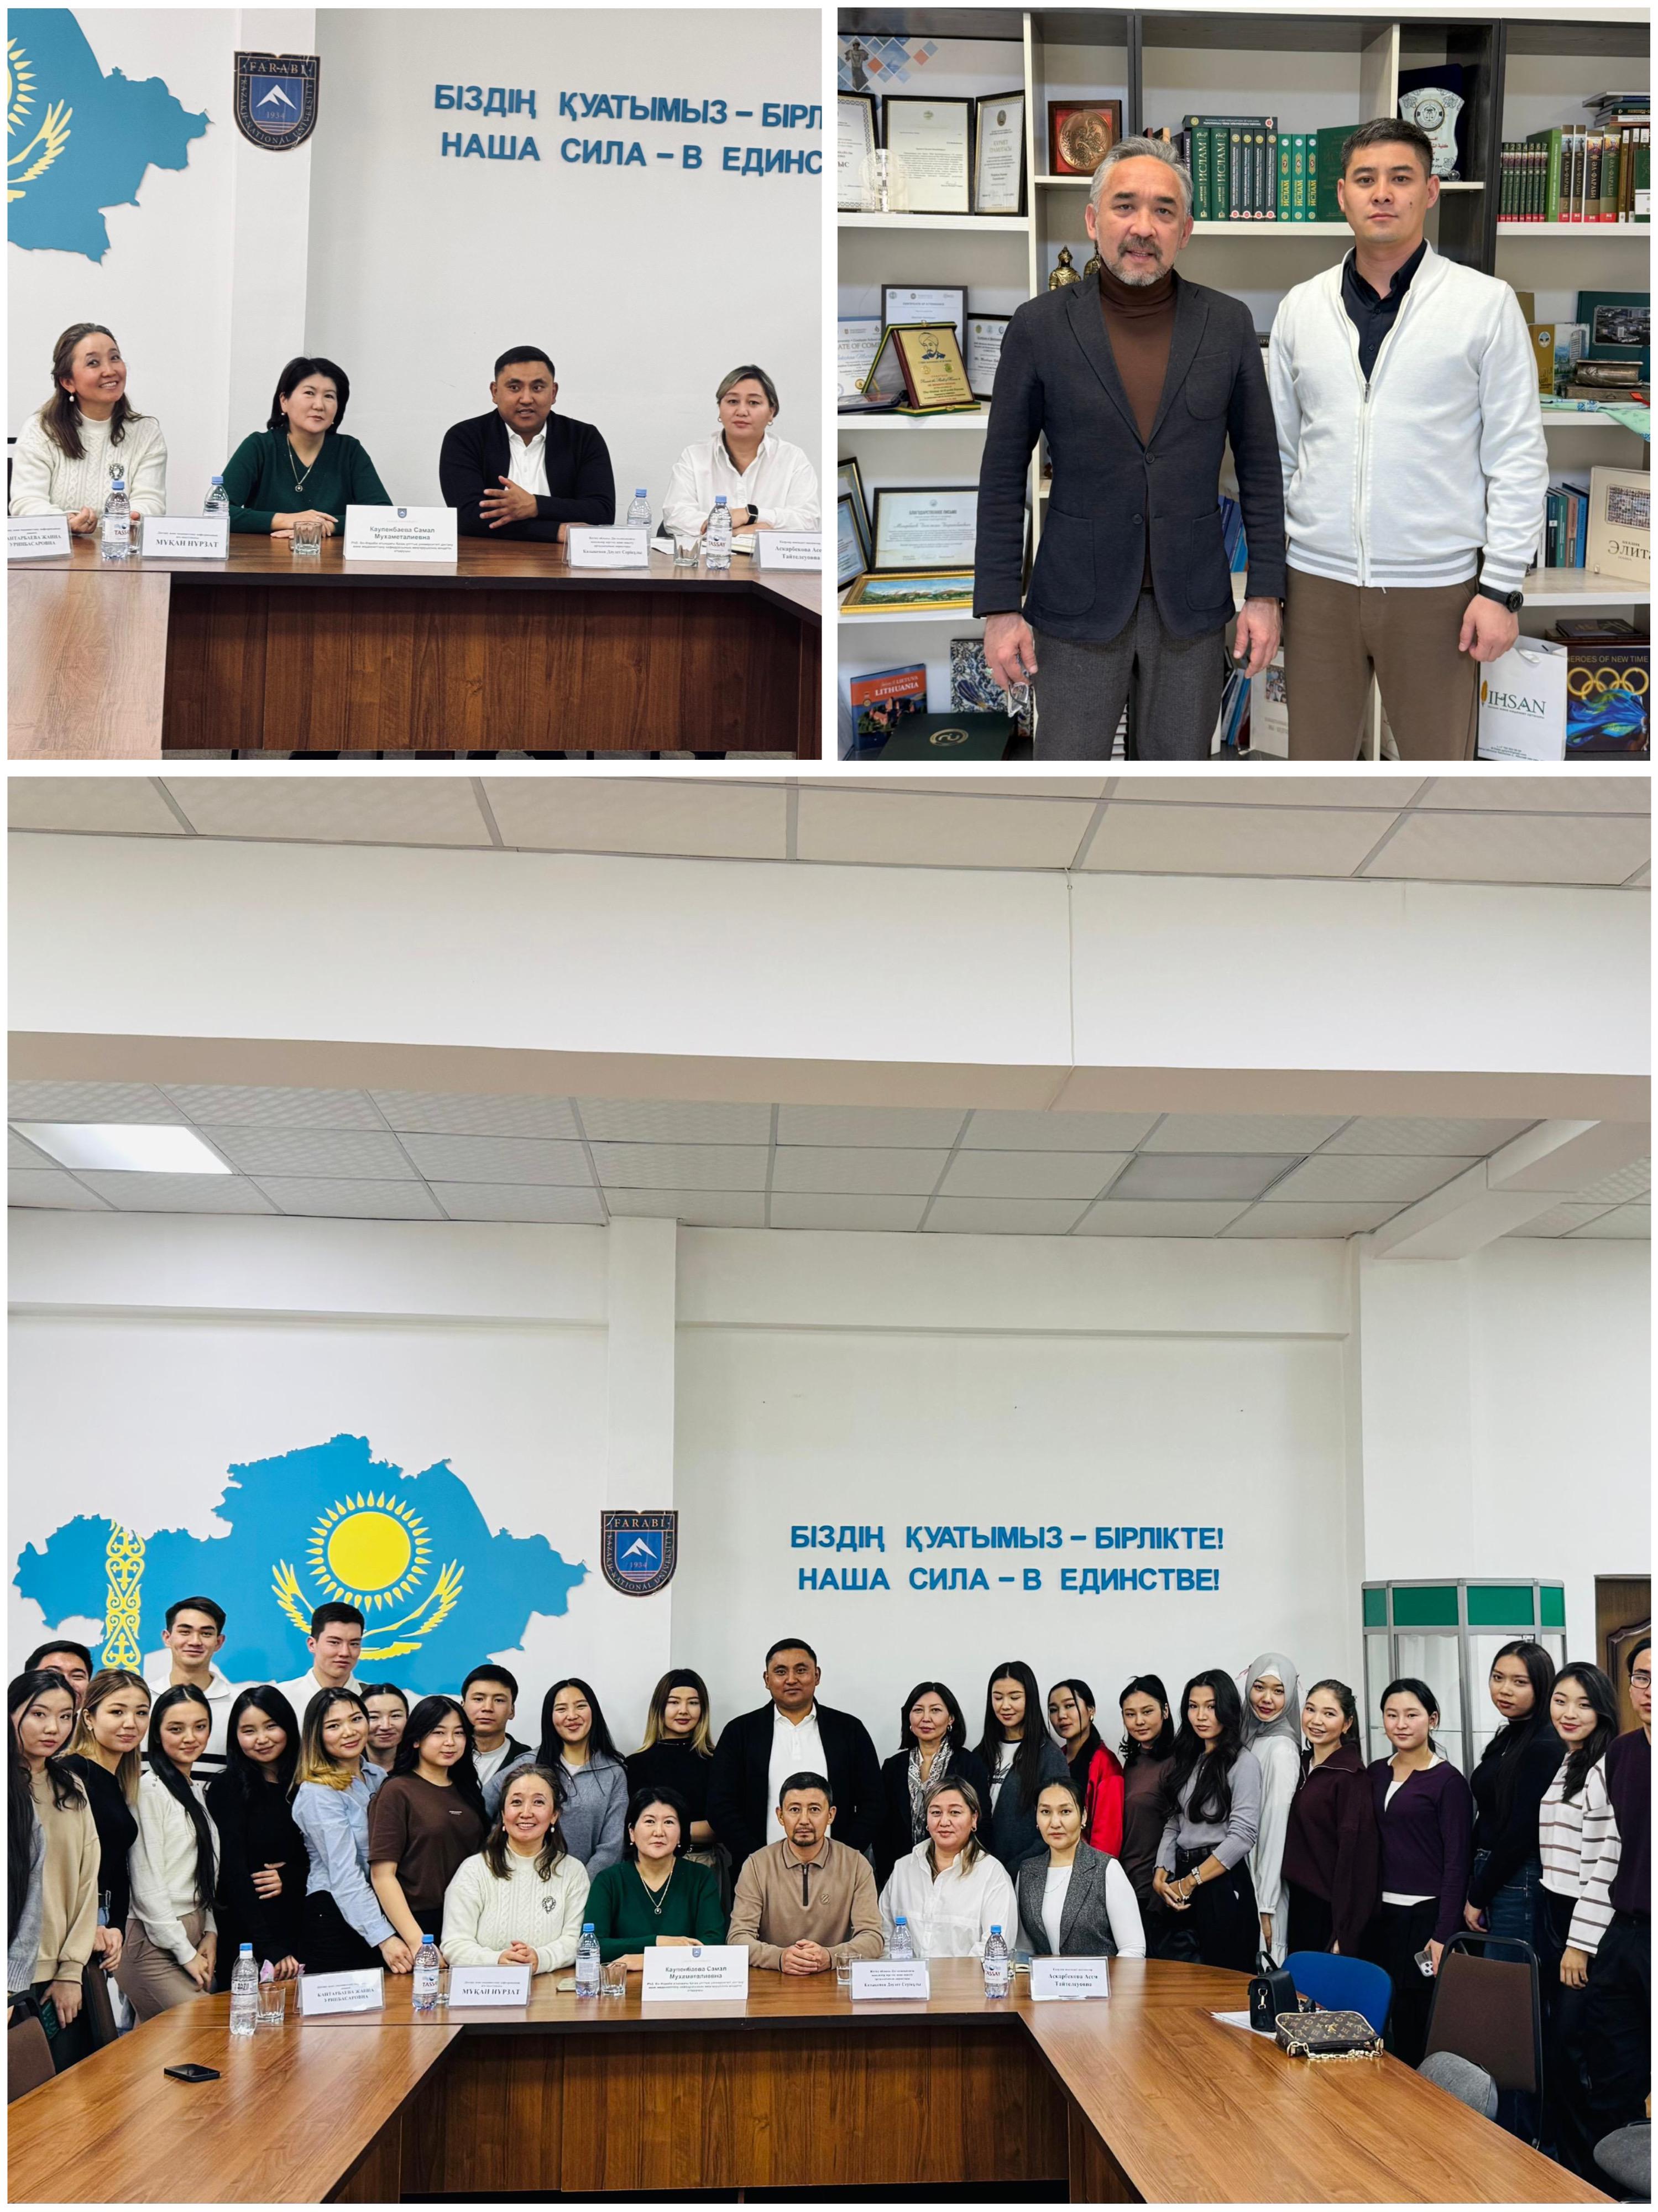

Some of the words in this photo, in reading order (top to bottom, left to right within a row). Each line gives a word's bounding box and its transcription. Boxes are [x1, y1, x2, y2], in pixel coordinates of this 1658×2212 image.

[249, 62, 306, 74] FARABI
[434, 84, 537, 119] БІЗДІҢ
[559, 91, 728, 124] ҚУАТЫМЫЗ
[245, 121, 291, 144] NATIONAL
[441, 132, 541, 161] НАША
[560, 138, 647, 167] СИЛА
[682, 144, 703, 170] В
[1199, 142, 1207, 181] ИСЛАМ
[1217, 143, 1226, 182] ИСЛАМ
[1608, 540, 1650, 560] ЭЛИТ
[875, 682, 919, 696] LITHUANIA
[1488, 690, 1546, 715] IHSAN
[614, 1519, 663, 1527] FARABI
[791, 1525, 885, 1552] БІЗДІҢ
[906, 1525, 1063, 1552] ҚУАТЫМЫЗ
[1095, 1526, 1224, 1550] БІРЛІКТЕ!
[611, 1572, 653, 1590] NATIONAL
[655, 1535, 672, 1584] UNIVERSITY
[798, 1568, 891, 1590] НАША
[909, 1567, 990, 1591] СИЛА
[1023, 1568, 1042, 1591] В
[1061, 1568, 1220, 1594] ЕДИНСТВЕ!
